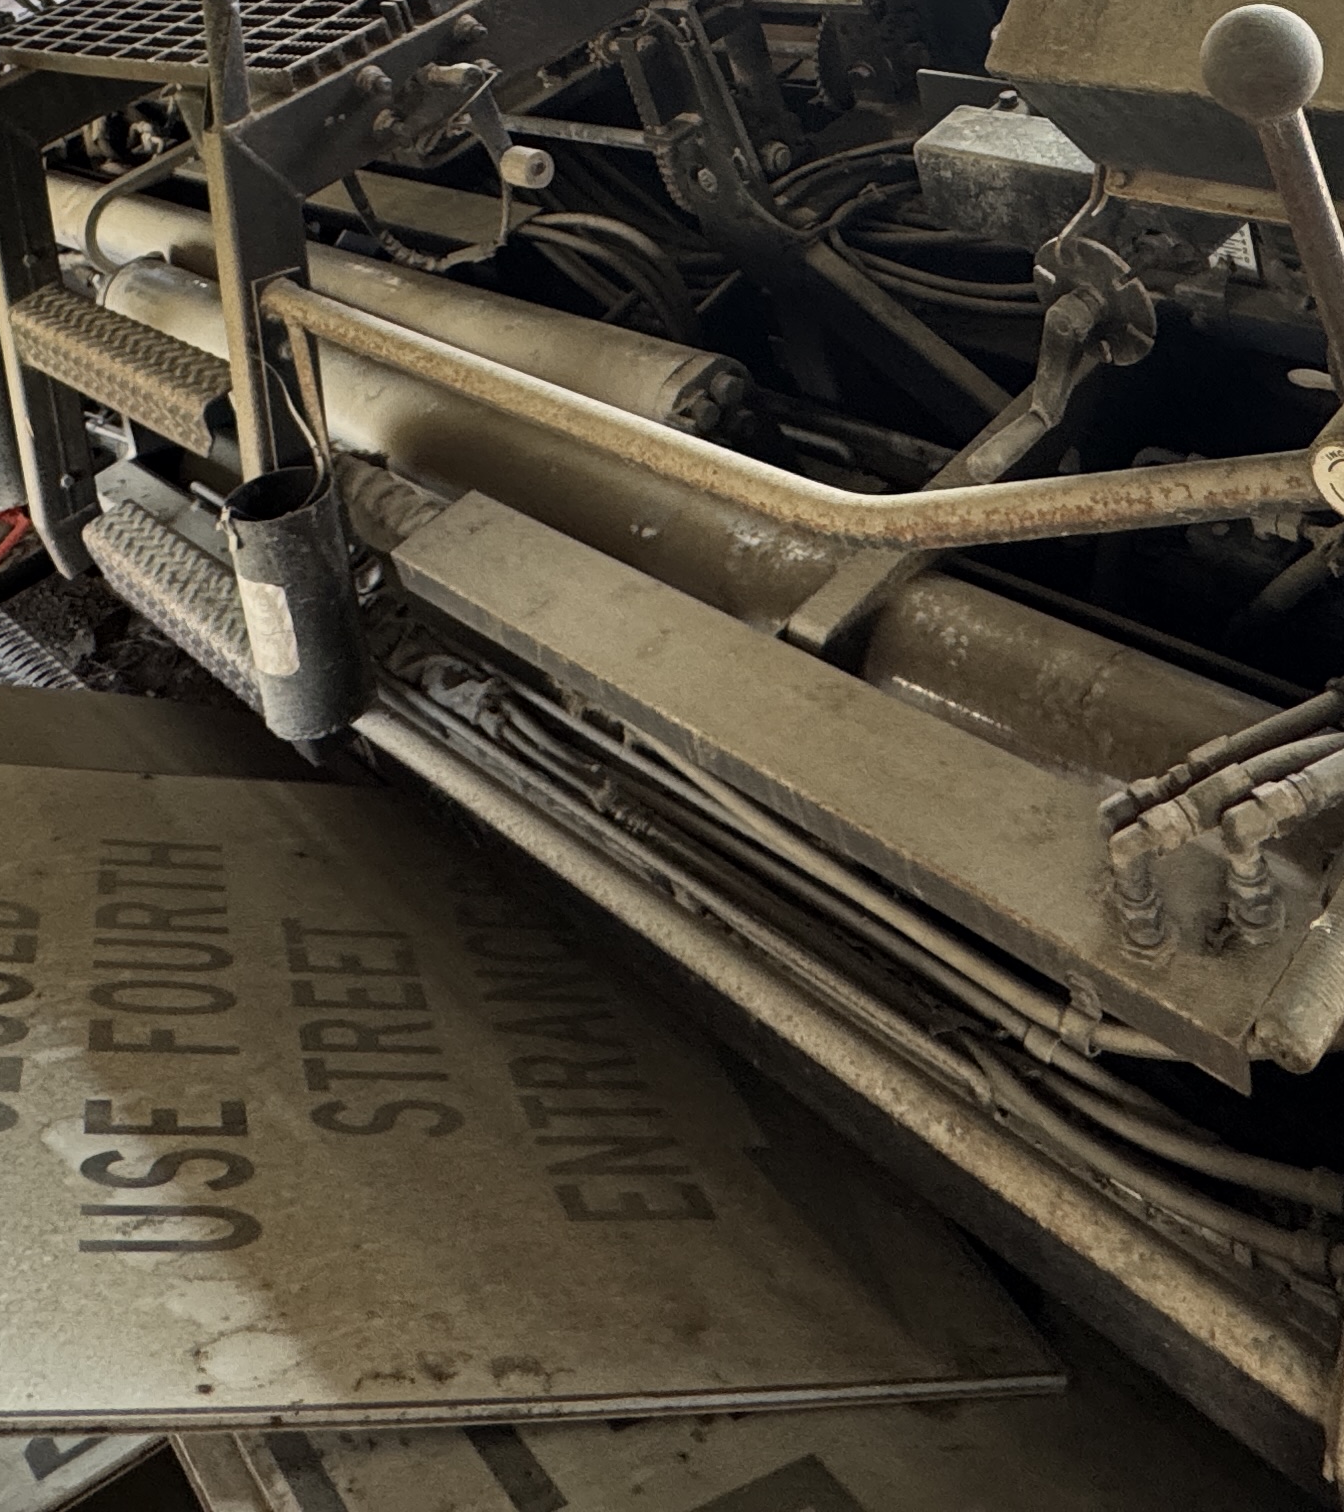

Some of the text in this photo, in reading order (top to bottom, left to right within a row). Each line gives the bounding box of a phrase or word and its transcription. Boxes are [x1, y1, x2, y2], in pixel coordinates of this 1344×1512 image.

[78, 838, 263, 1254] USE FOURTH
[282, 916, 465, 1138] STREET
